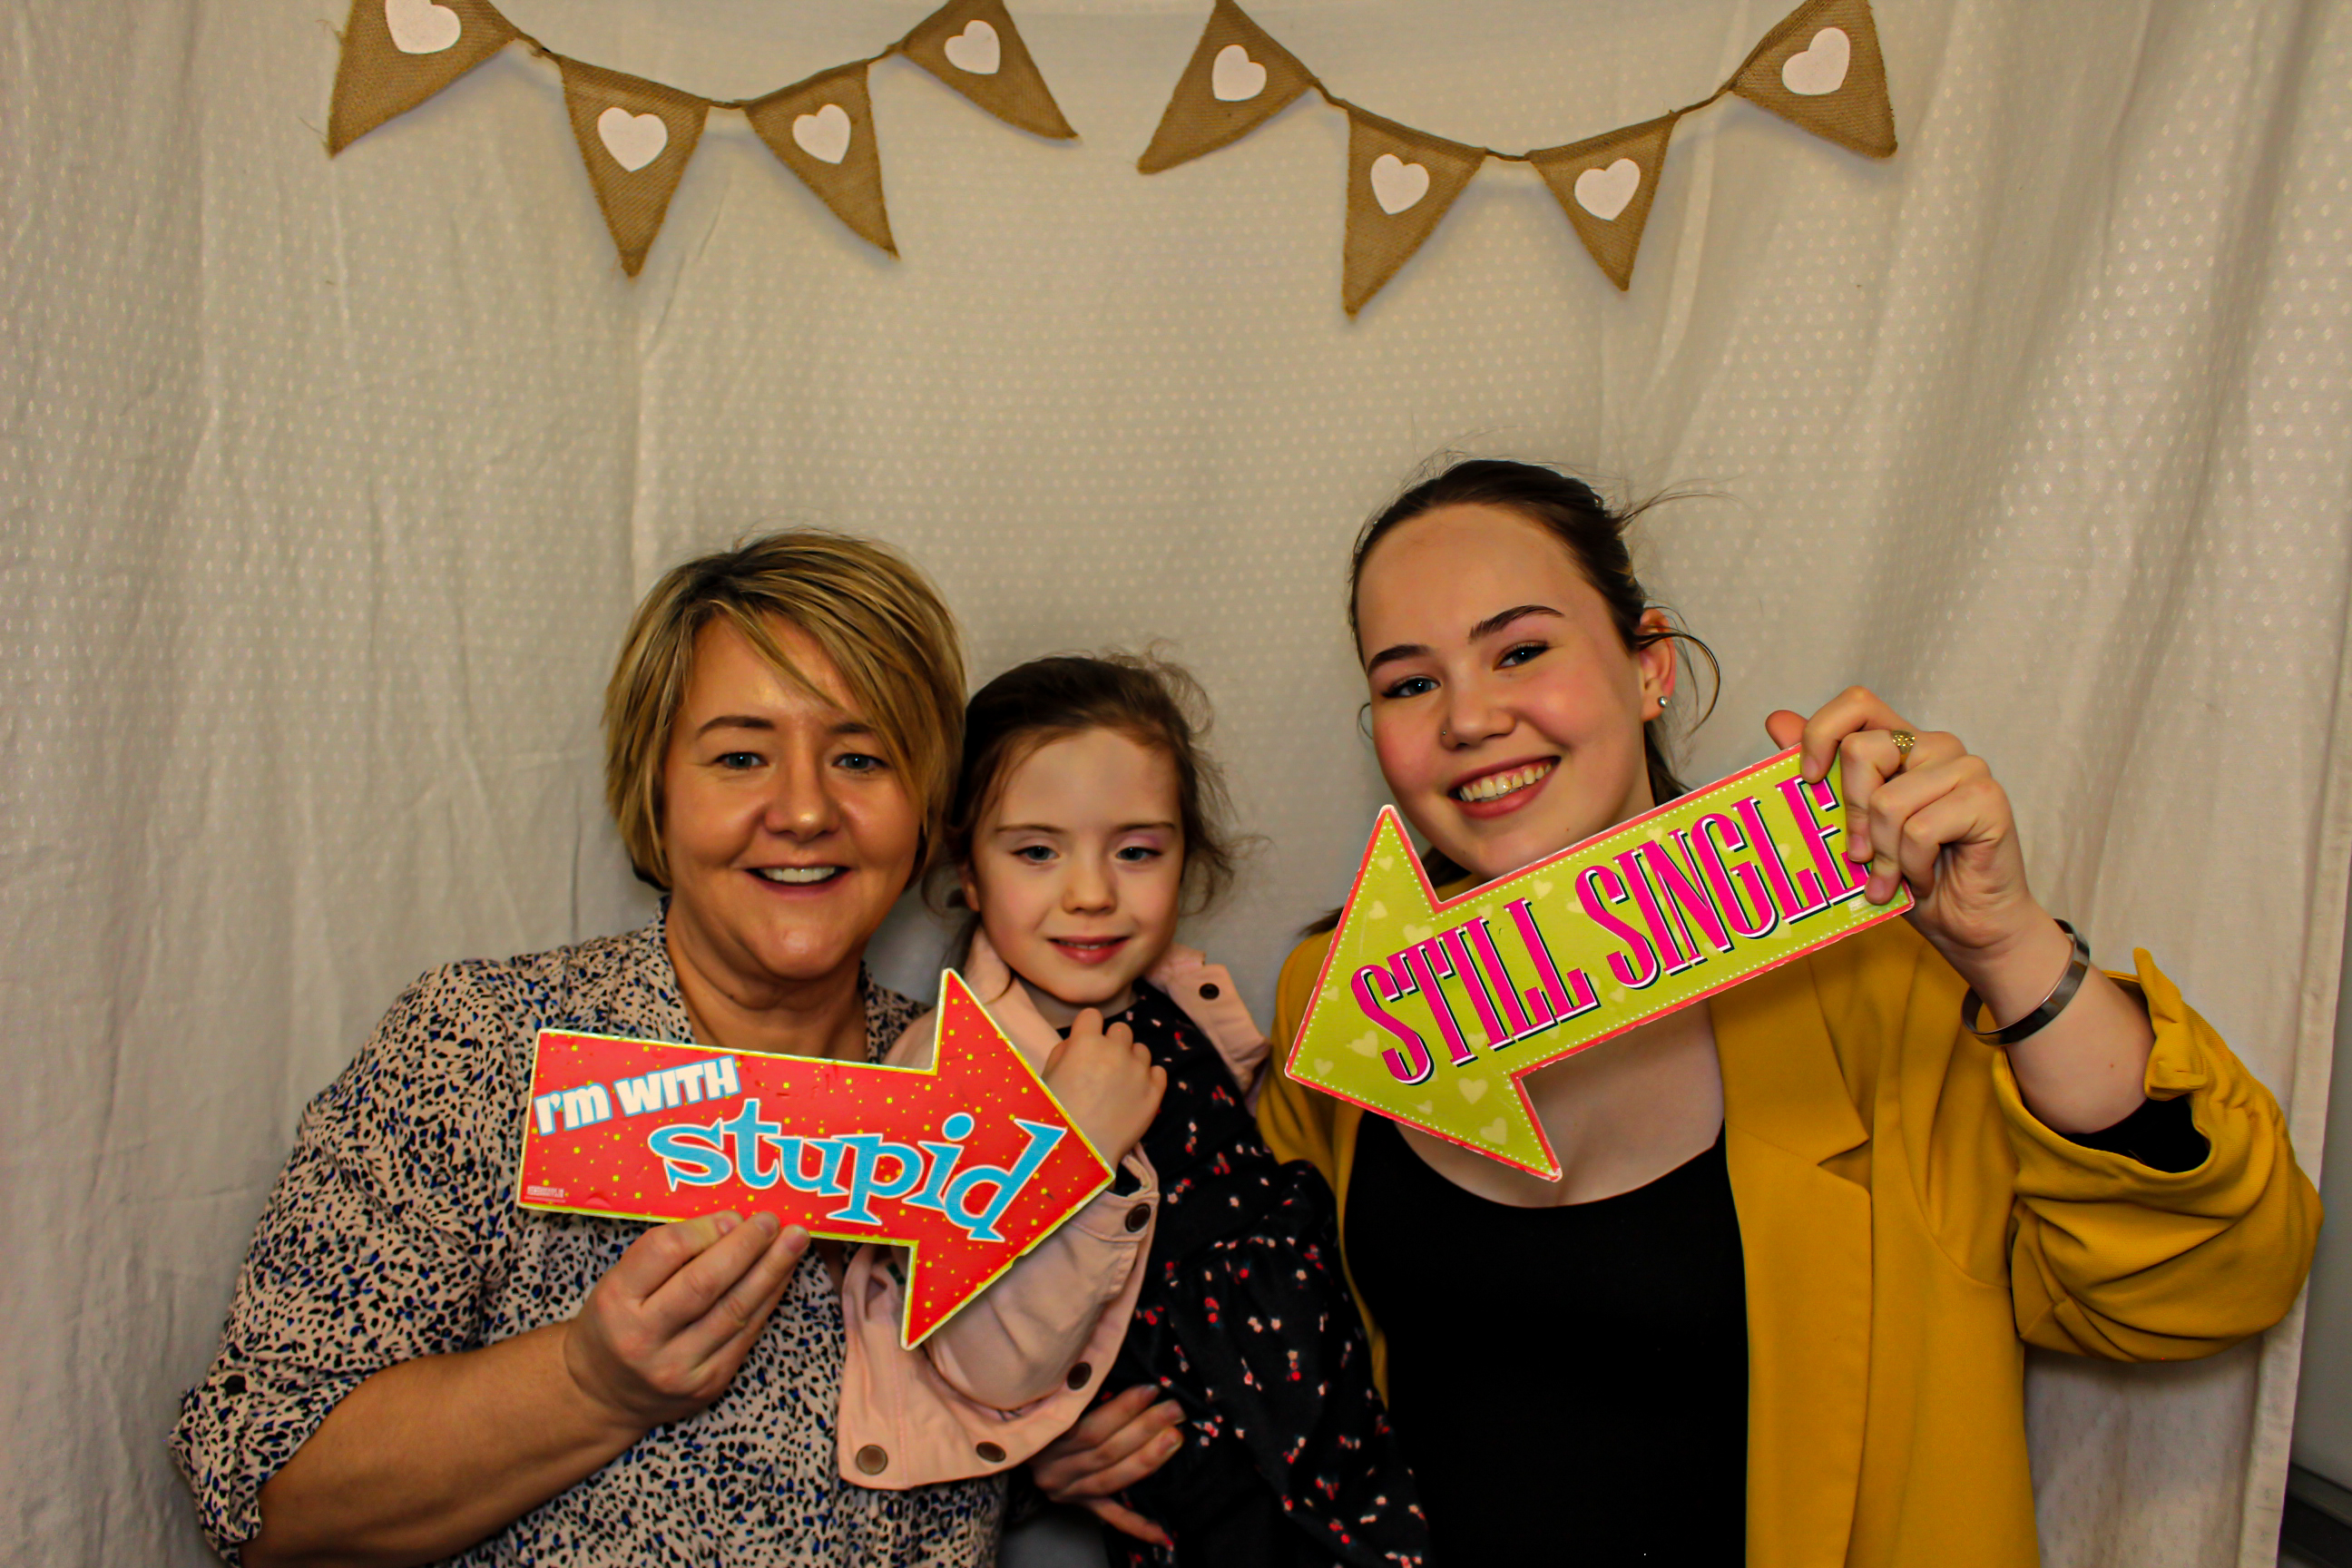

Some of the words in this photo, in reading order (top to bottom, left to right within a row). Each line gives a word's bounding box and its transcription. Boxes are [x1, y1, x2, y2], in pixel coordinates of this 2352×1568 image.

[1350, 897, 1602, 1086] STILL
[1574, 773, 1873, 990] SINGLE
[613, 1055, 741, 1117] WITH
[647, 1097, 1068, 1242] stupid
